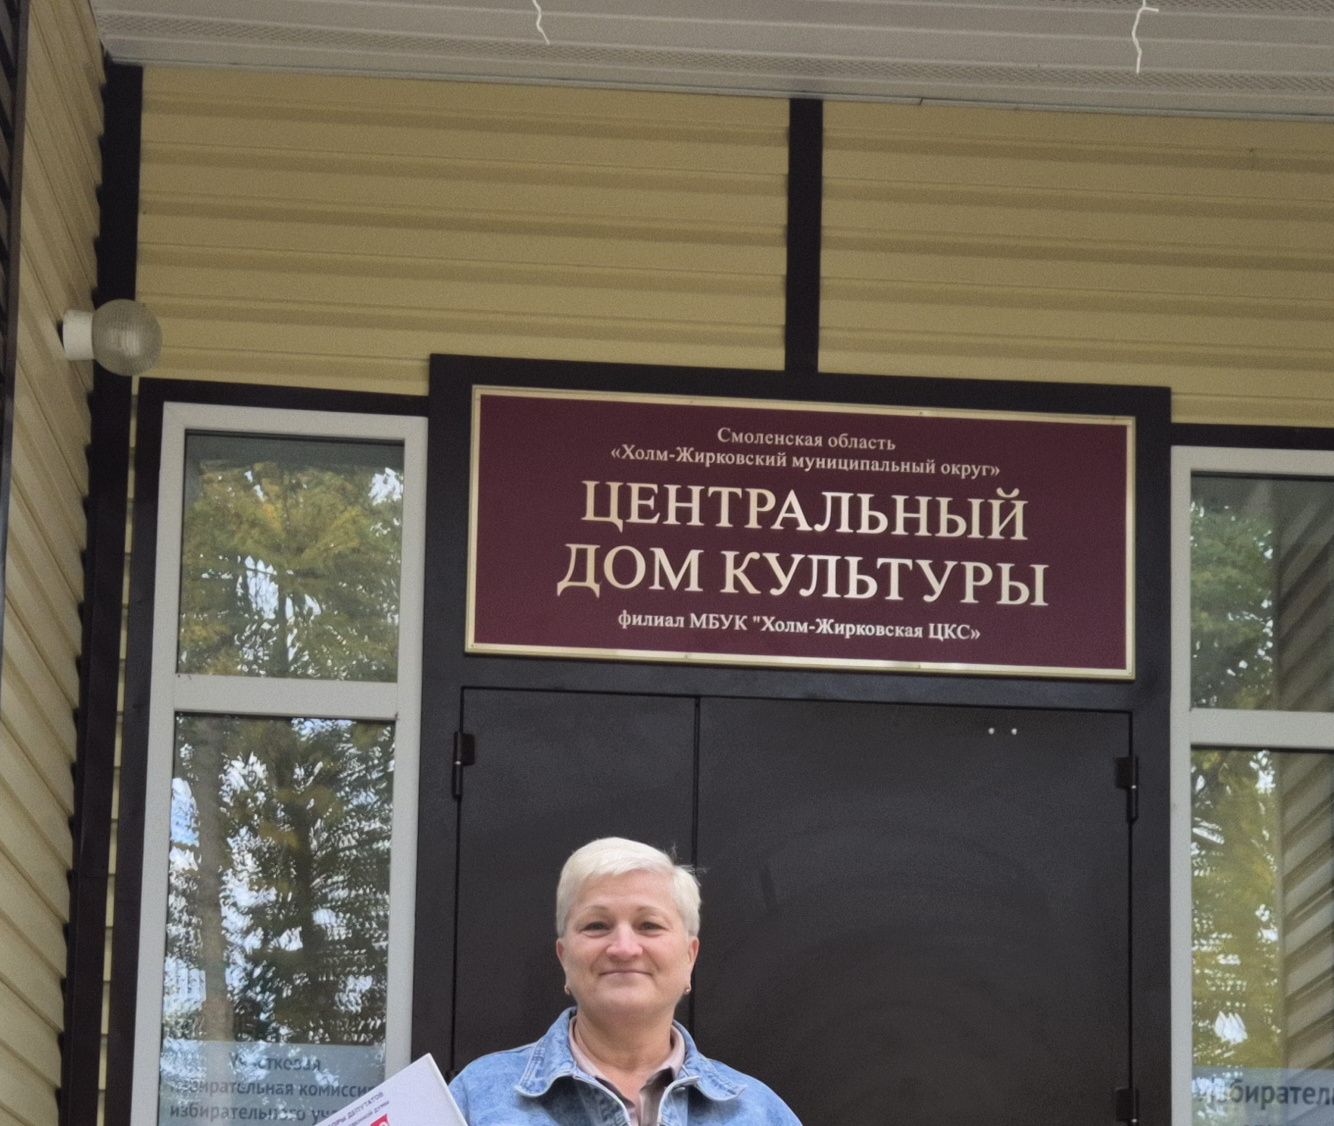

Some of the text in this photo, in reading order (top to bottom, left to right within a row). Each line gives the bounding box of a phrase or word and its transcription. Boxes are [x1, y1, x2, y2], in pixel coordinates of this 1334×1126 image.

[717, 427, 896, 451] Смоленская область
[611, 443, 1000, 480] «Холм-Жирковский муниципальный округ»
[581, 480, 1028, 541] ЦЕНТРАЛЬНЫЙ
[556, 543, 1049, 606] ДОМ КУЛЬТУРЫ
[618, 609, 981, 642] филиал МБУК "Холм-Жирковская ЦКС»
[229, 1051, 321, 1071] Устковая
[170, 1079, 376, 1098] бирательная комисси
